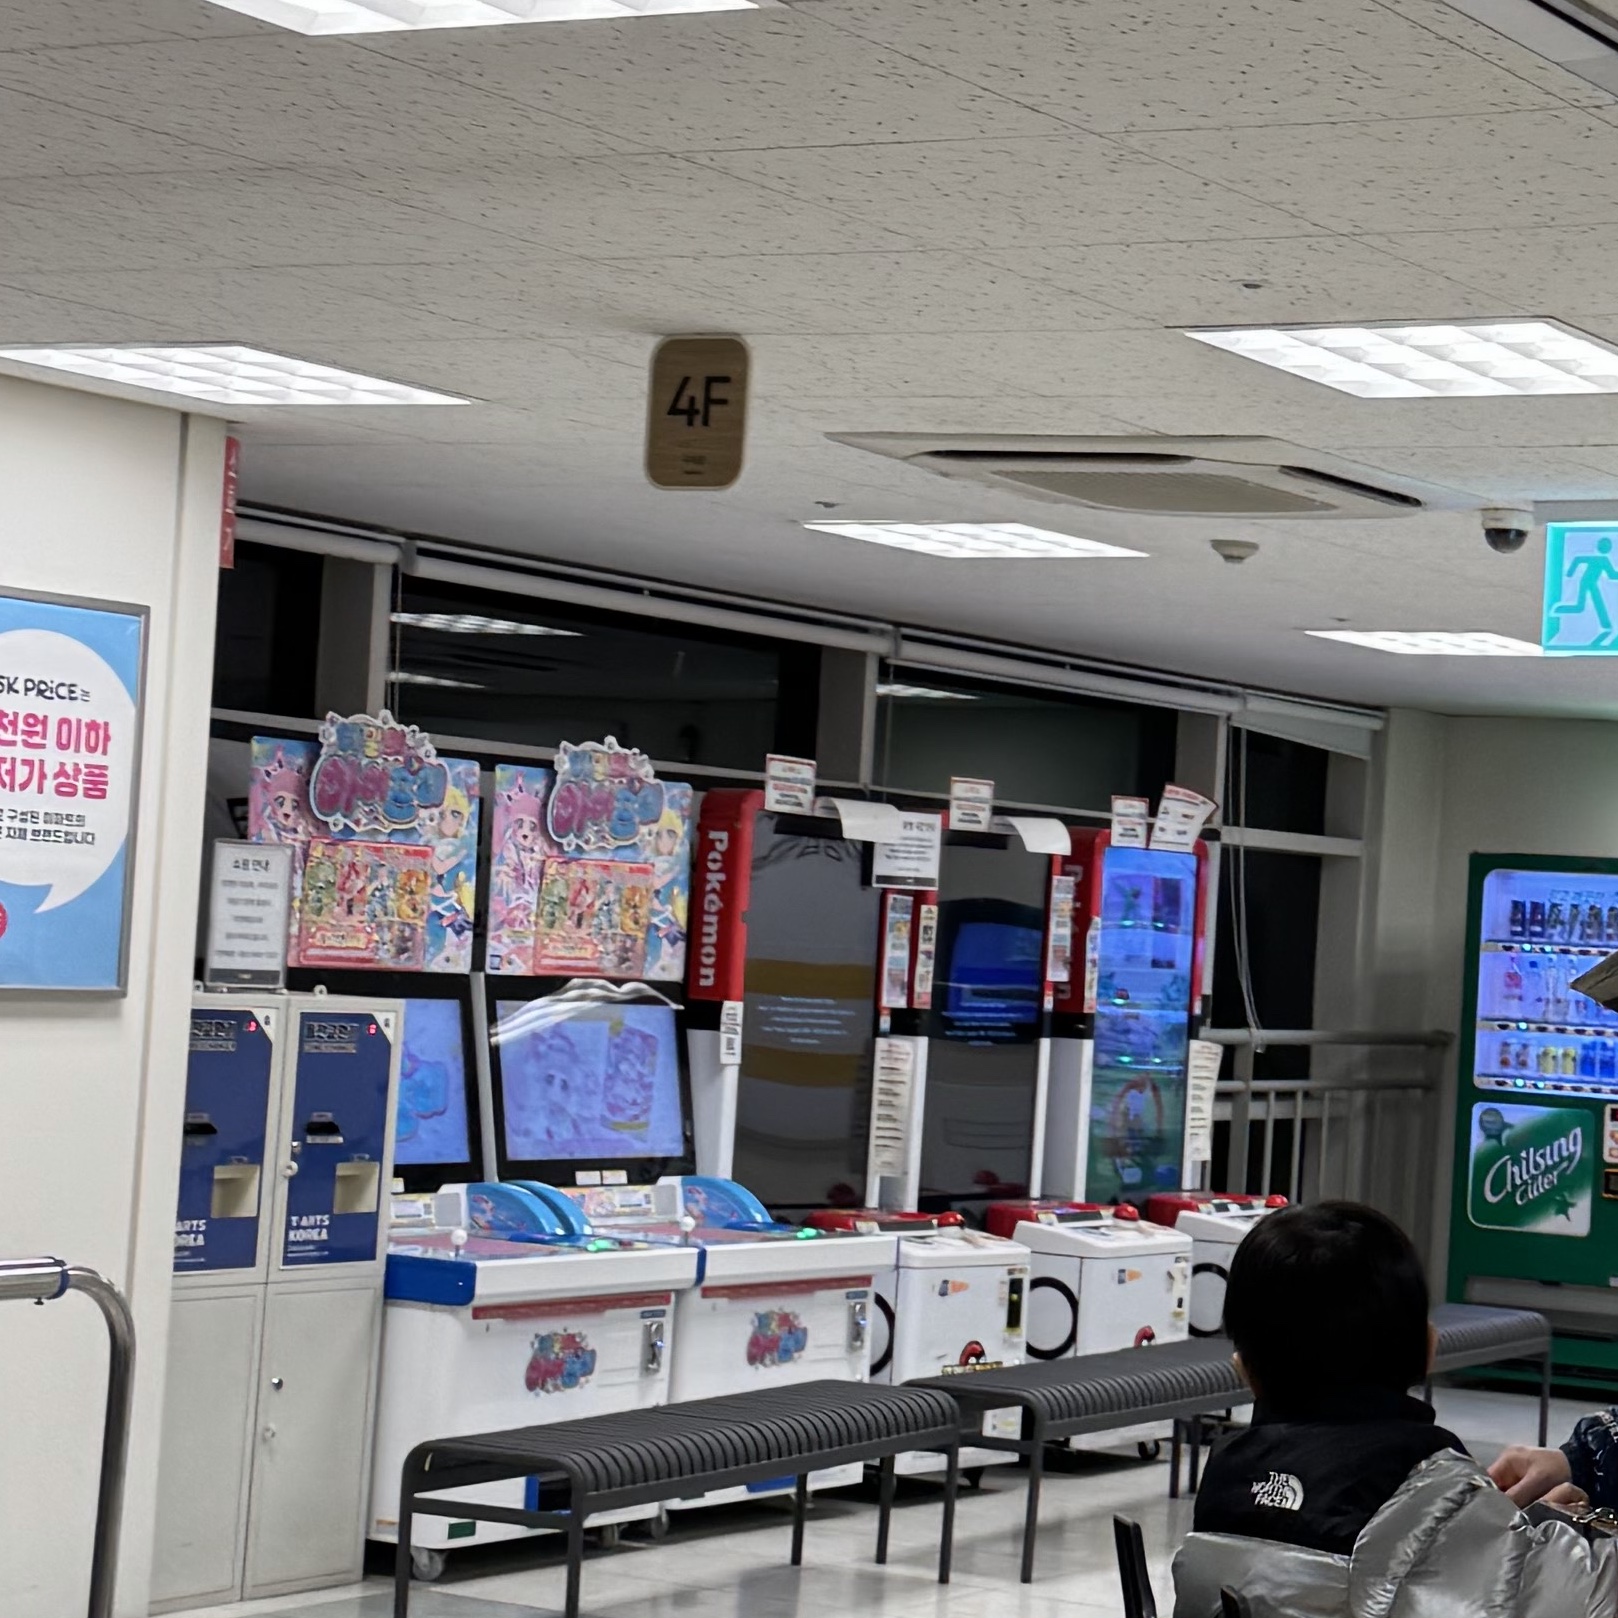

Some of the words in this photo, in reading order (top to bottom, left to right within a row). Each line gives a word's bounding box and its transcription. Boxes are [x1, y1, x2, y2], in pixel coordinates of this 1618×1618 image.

[667, 375, 731, 427] 4F
[56, 717, 111, 756] 이하
[53, 761, 109, 800] 상품
[699, 830, 730, 987] Pokémon
